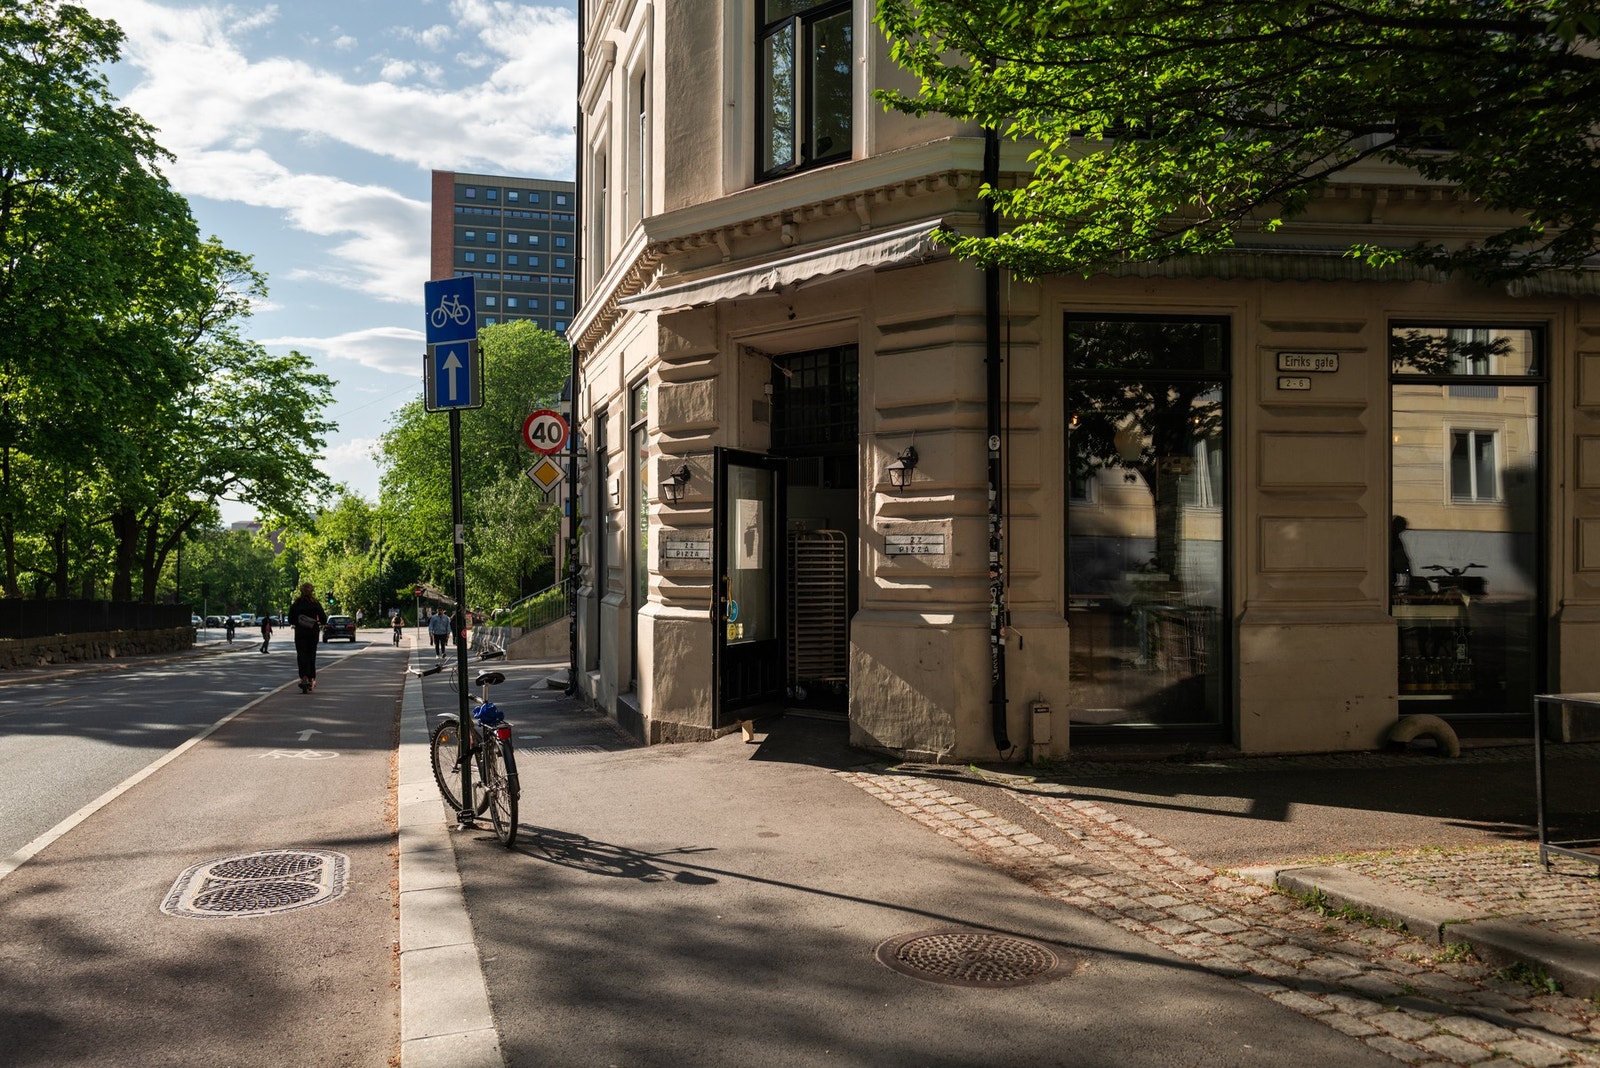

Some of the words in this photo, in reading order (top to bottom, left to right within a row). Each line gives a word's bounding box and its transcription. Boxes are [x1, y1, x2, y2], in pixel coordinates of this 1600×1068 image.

[1285, 355, 1311, 367] Eiriks
[1315, 356, 1334, 370] gate
[532, 421, 562, 444] 40
